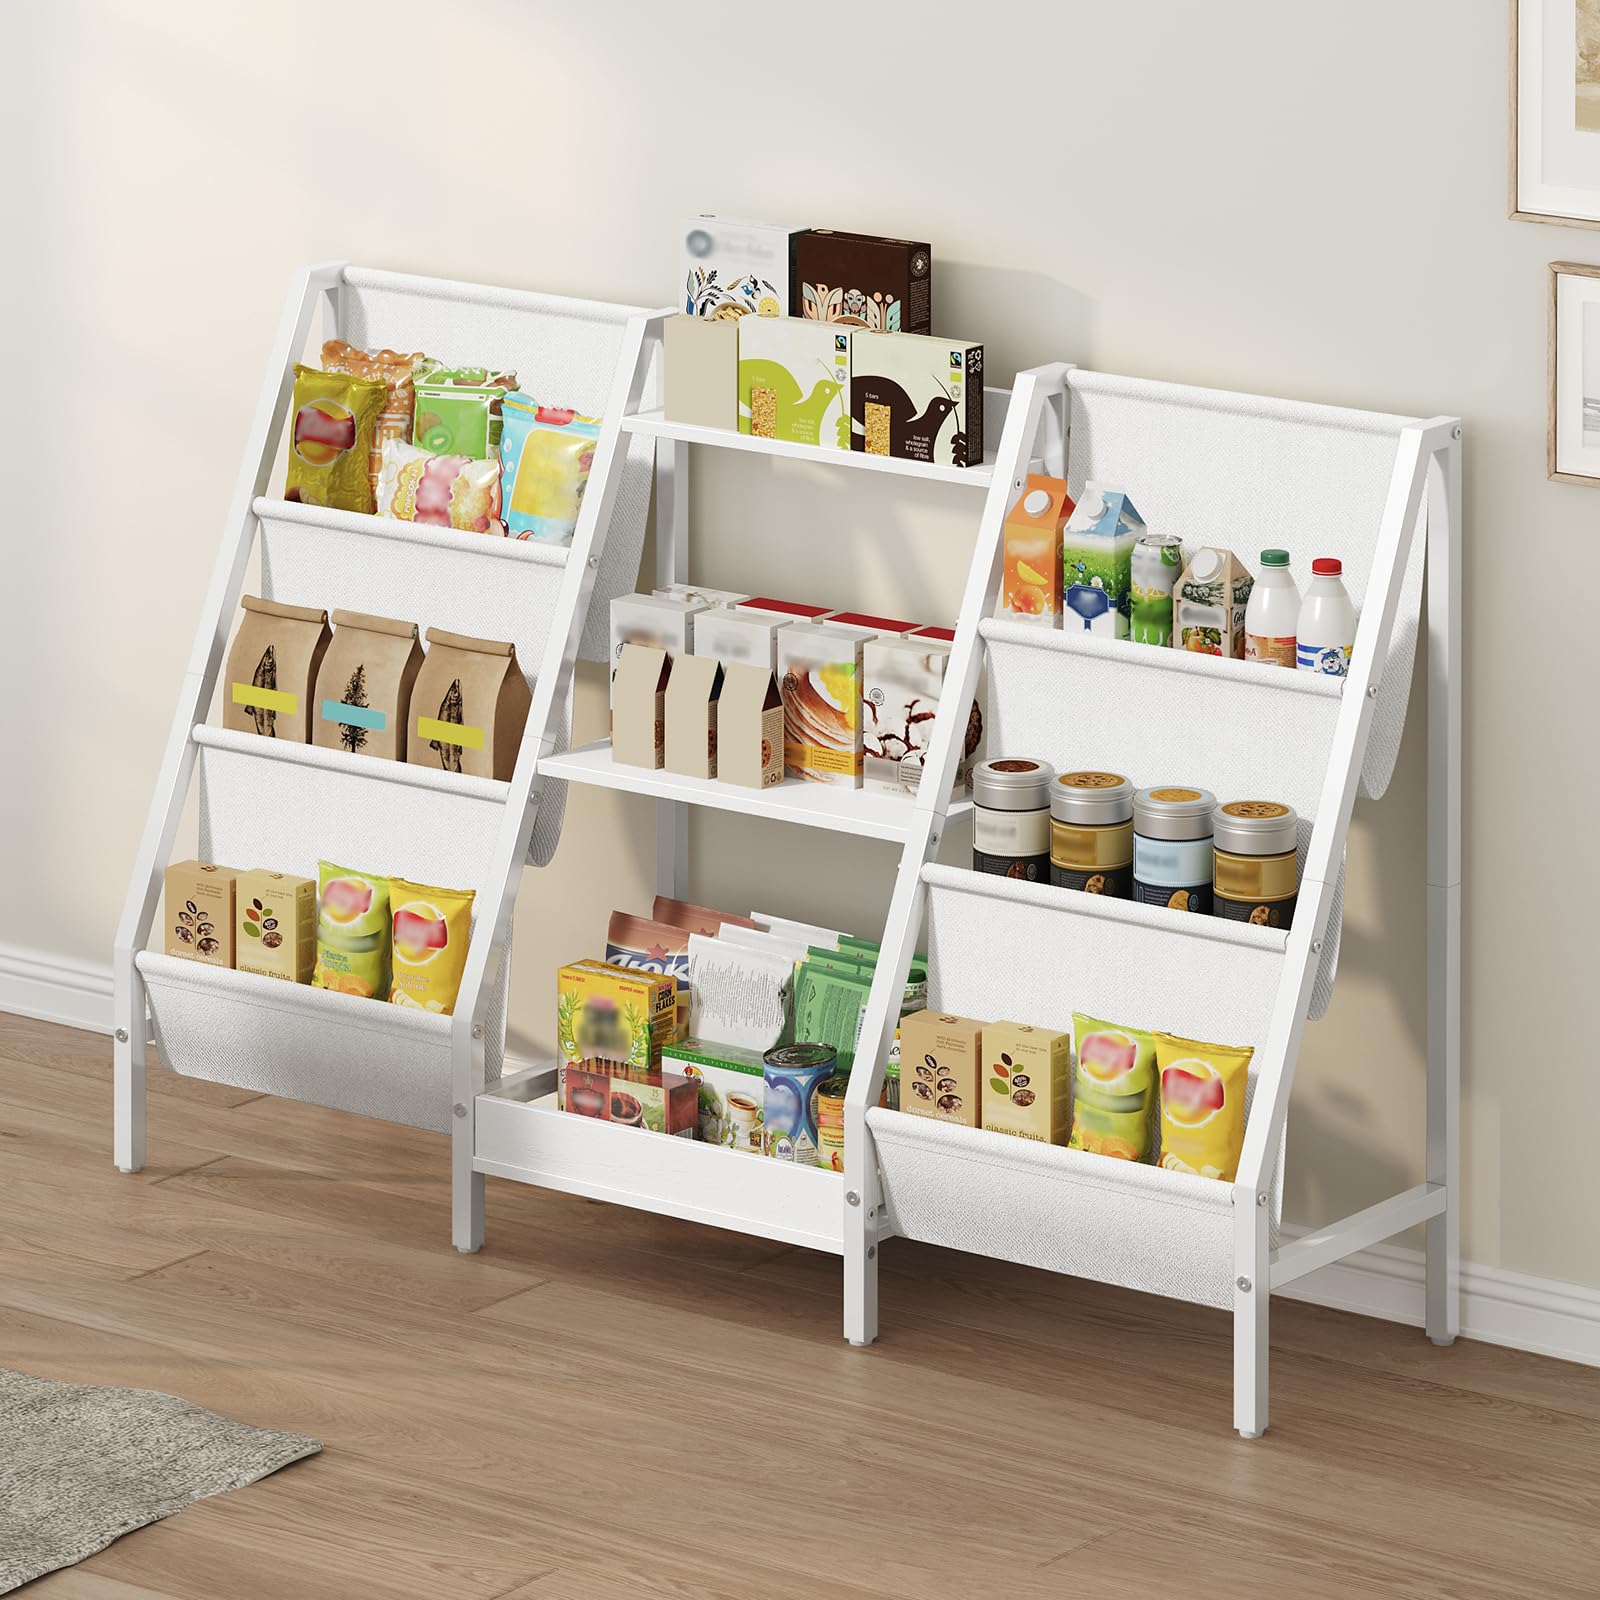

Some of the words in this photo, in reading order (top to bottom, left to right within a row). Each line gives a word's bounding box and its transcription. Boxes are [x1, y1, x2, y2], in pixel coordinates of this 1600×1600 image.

[905, 439, 928, 448] wholegrain
[404, 470, 418, 513] POPCORN
[170, 948, 195, 959] dorset
[240, 965, 267, 977] classic
[657, 989, 673, 1002] CORN
[655, 996, 676, 1013] FLAKES
[906, 1105, 935, 1118] dorset
[936, 1112, 968, 1124] cereals
[986, 1123, 1017, 1137] classic
[1018, 1130, 1047, 1143] fruits.
